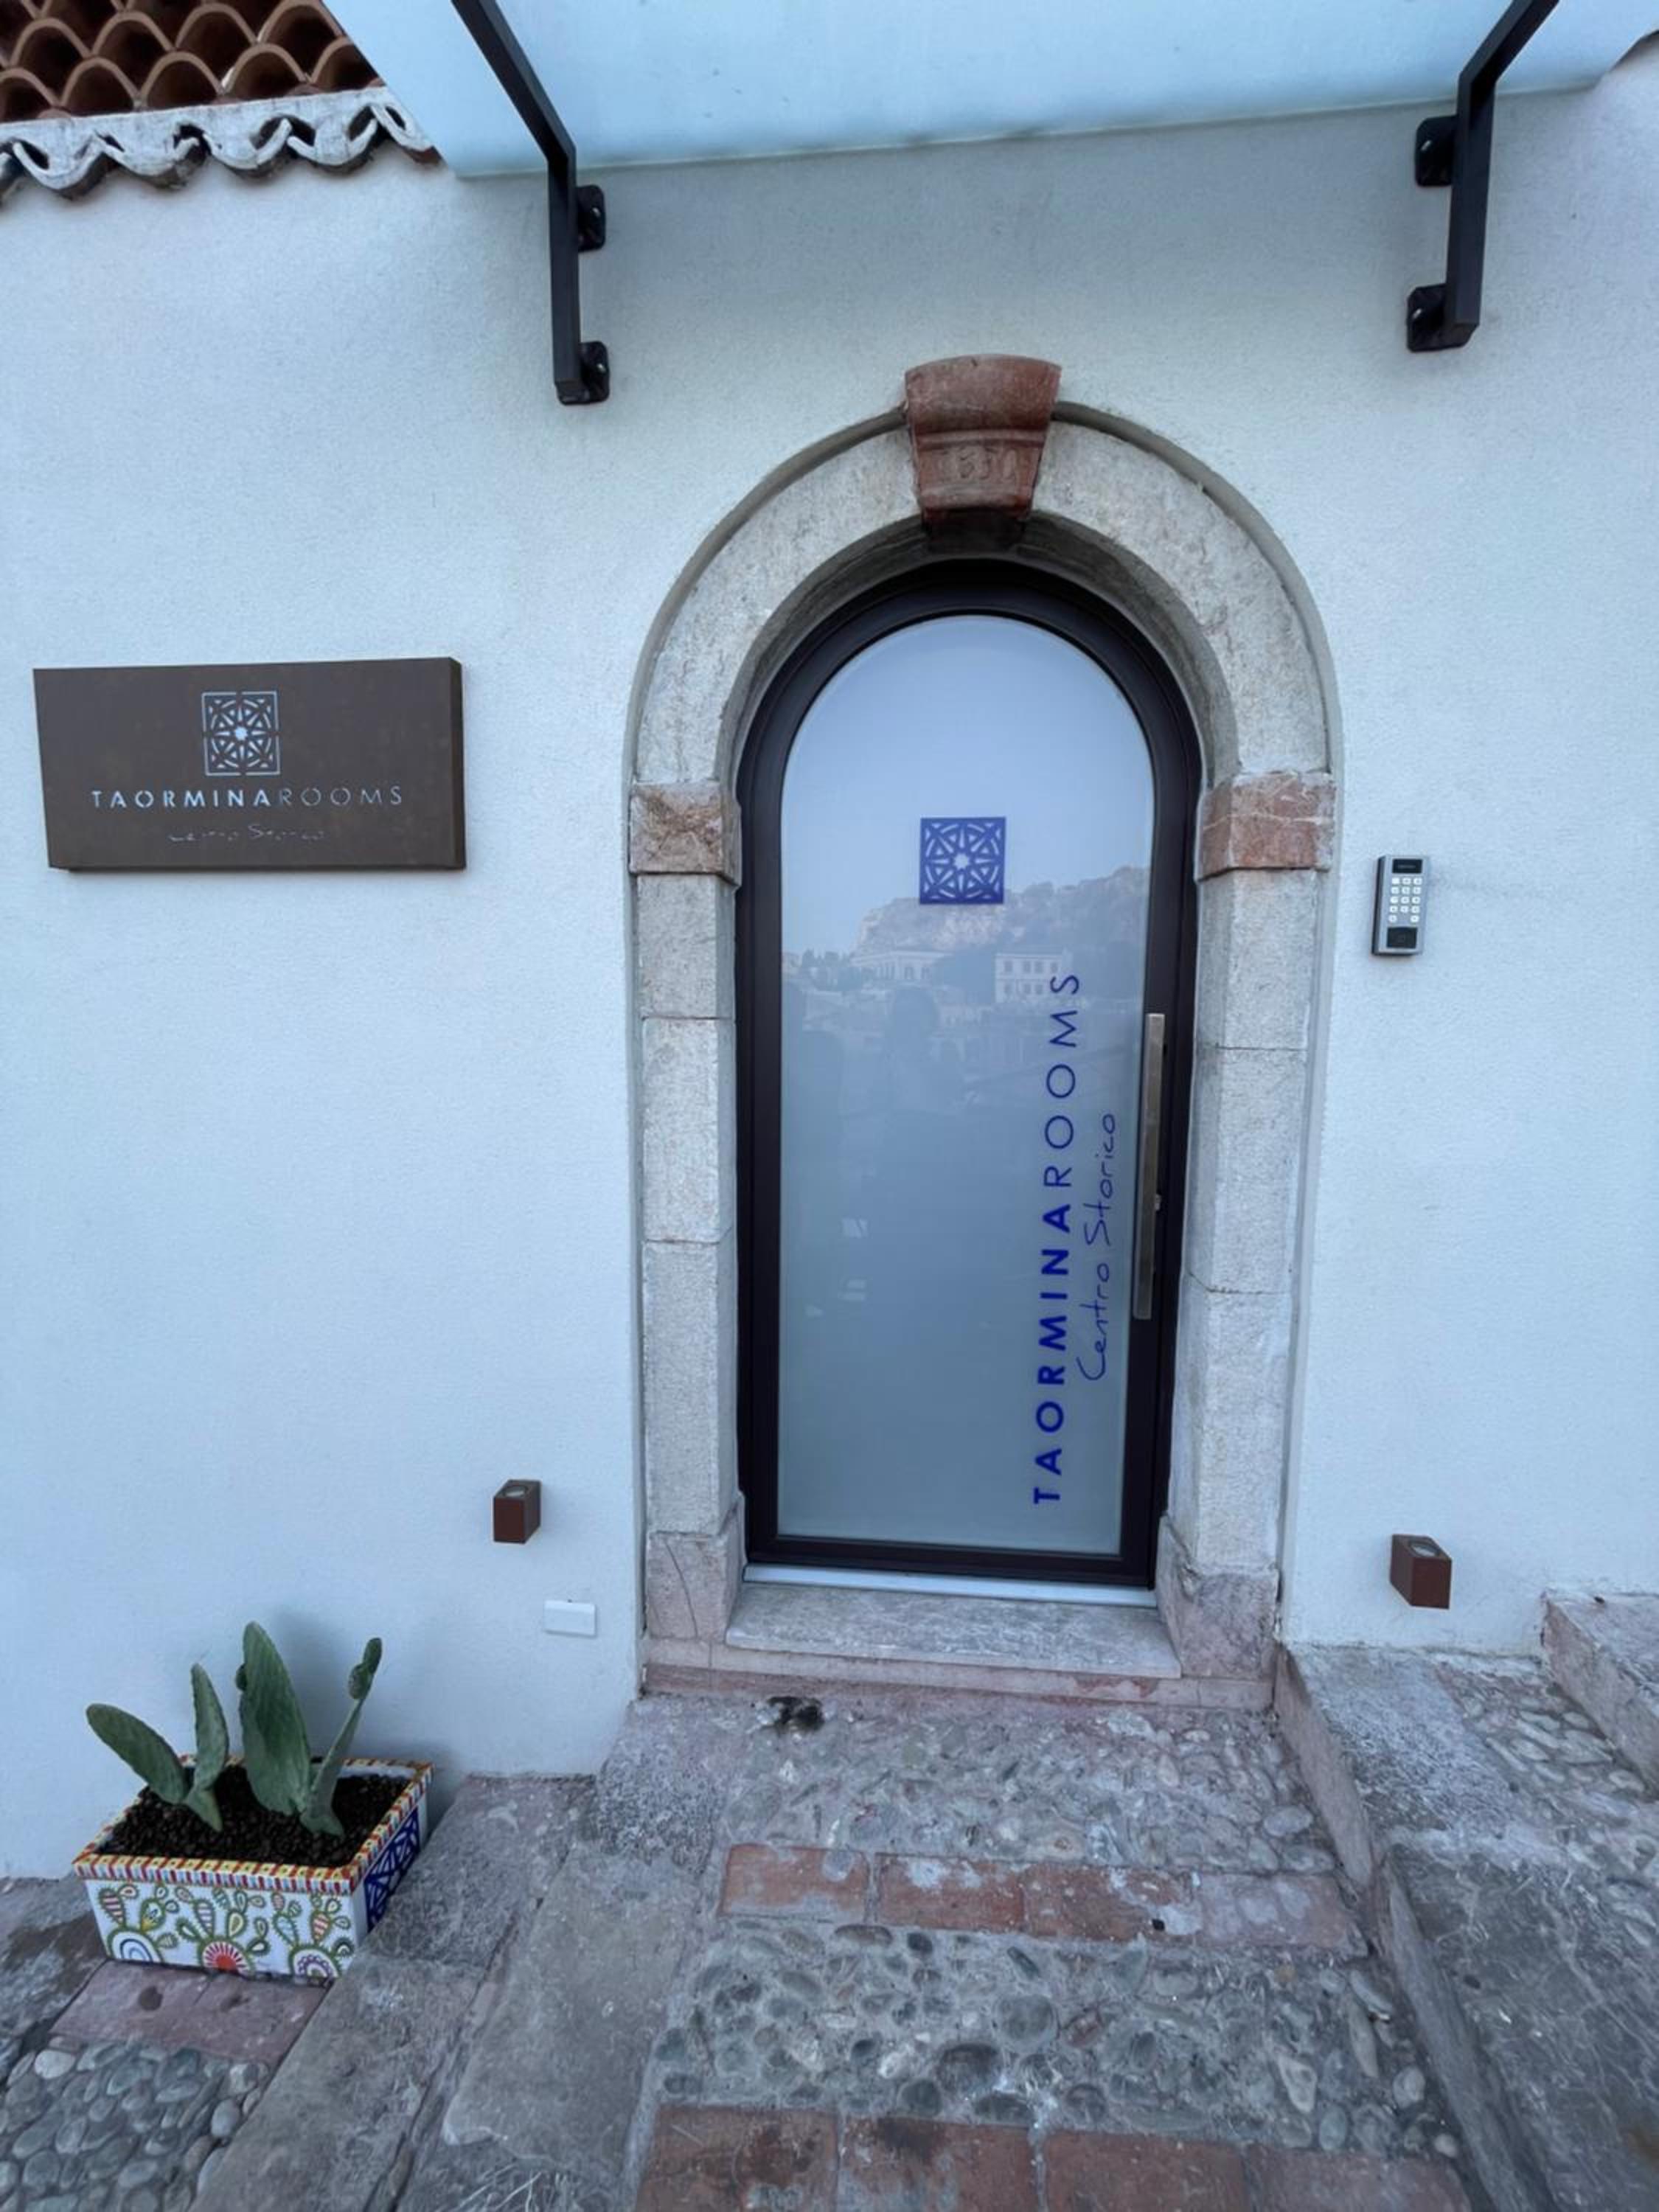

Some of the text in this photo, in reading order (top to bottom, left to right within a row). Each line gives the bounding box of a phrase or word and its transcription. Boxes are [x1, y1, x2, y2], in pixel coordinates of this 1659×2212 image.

[1033, 975, 1079, 1505] TAORMINAROOMS
[1076, 1113, 1116, 1381] Centro Storico
